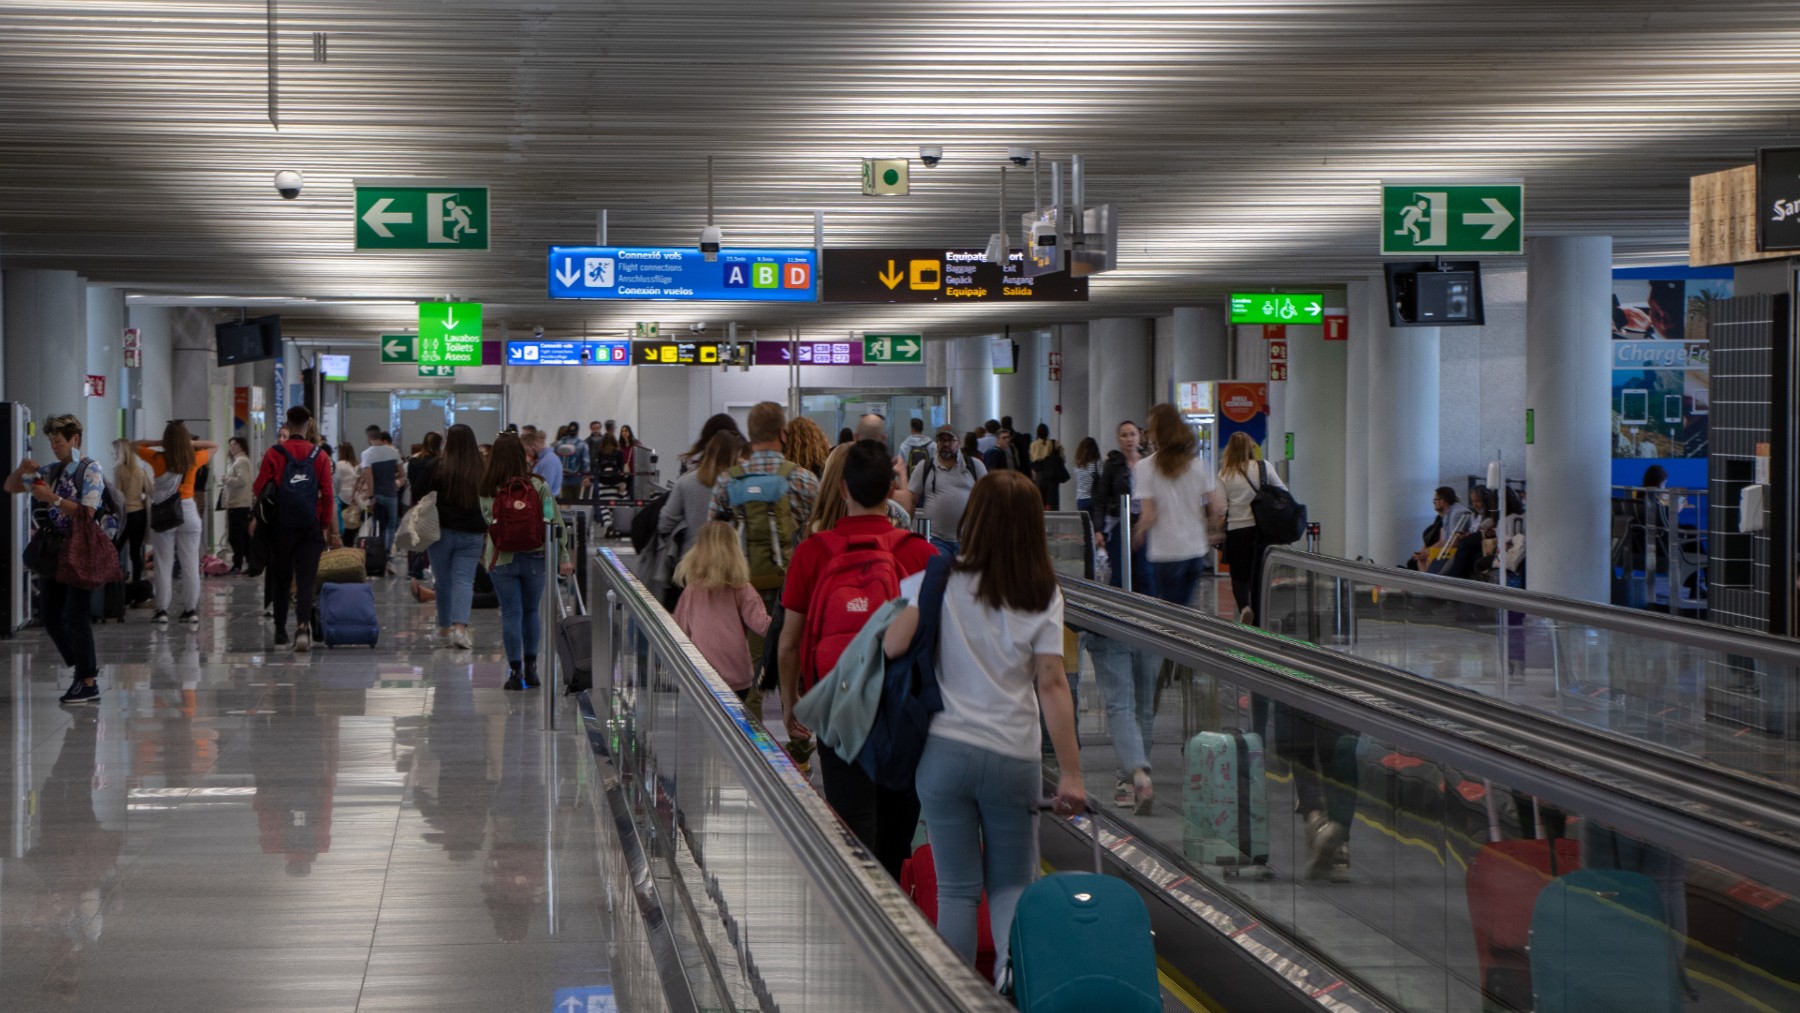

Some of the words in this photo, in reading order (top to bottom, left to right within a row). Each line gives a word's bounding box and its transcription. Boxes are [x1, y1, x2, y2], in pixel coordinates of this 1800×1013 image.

[618, 250, 661, 260] Connexió
[663, 252, 682, 260] vols
[946, 251, 987, 262] Equipatg
[618, 263, 638, 272] Flight
[640, 264, 682, 272] connections
[946, 264, 976, 274] Baggage
[1003, 264, 1016, 272] Exit
[618, 274, 672, 284] Anschlussflüge
[728, 266, 744, 284] A
[759, 266, 773, 284] B
[791, 267, 805, 285] D
[946, 276, 972, 285] Gepäck
[1002, 276, 1034, 285] Ausgang
[618, 286, 661, 295] Conexión
[664, 287, 693, 295] vuelos
[946, 287, 987, 297] Equipaje
[1003, 287, 1032, 296] Salida
[445, 334, 480, 342] Lavabos
[445, 343, 474, 352] Toilets
[599, 350, 607, 359] B
[615, 350, 623, 359] D
